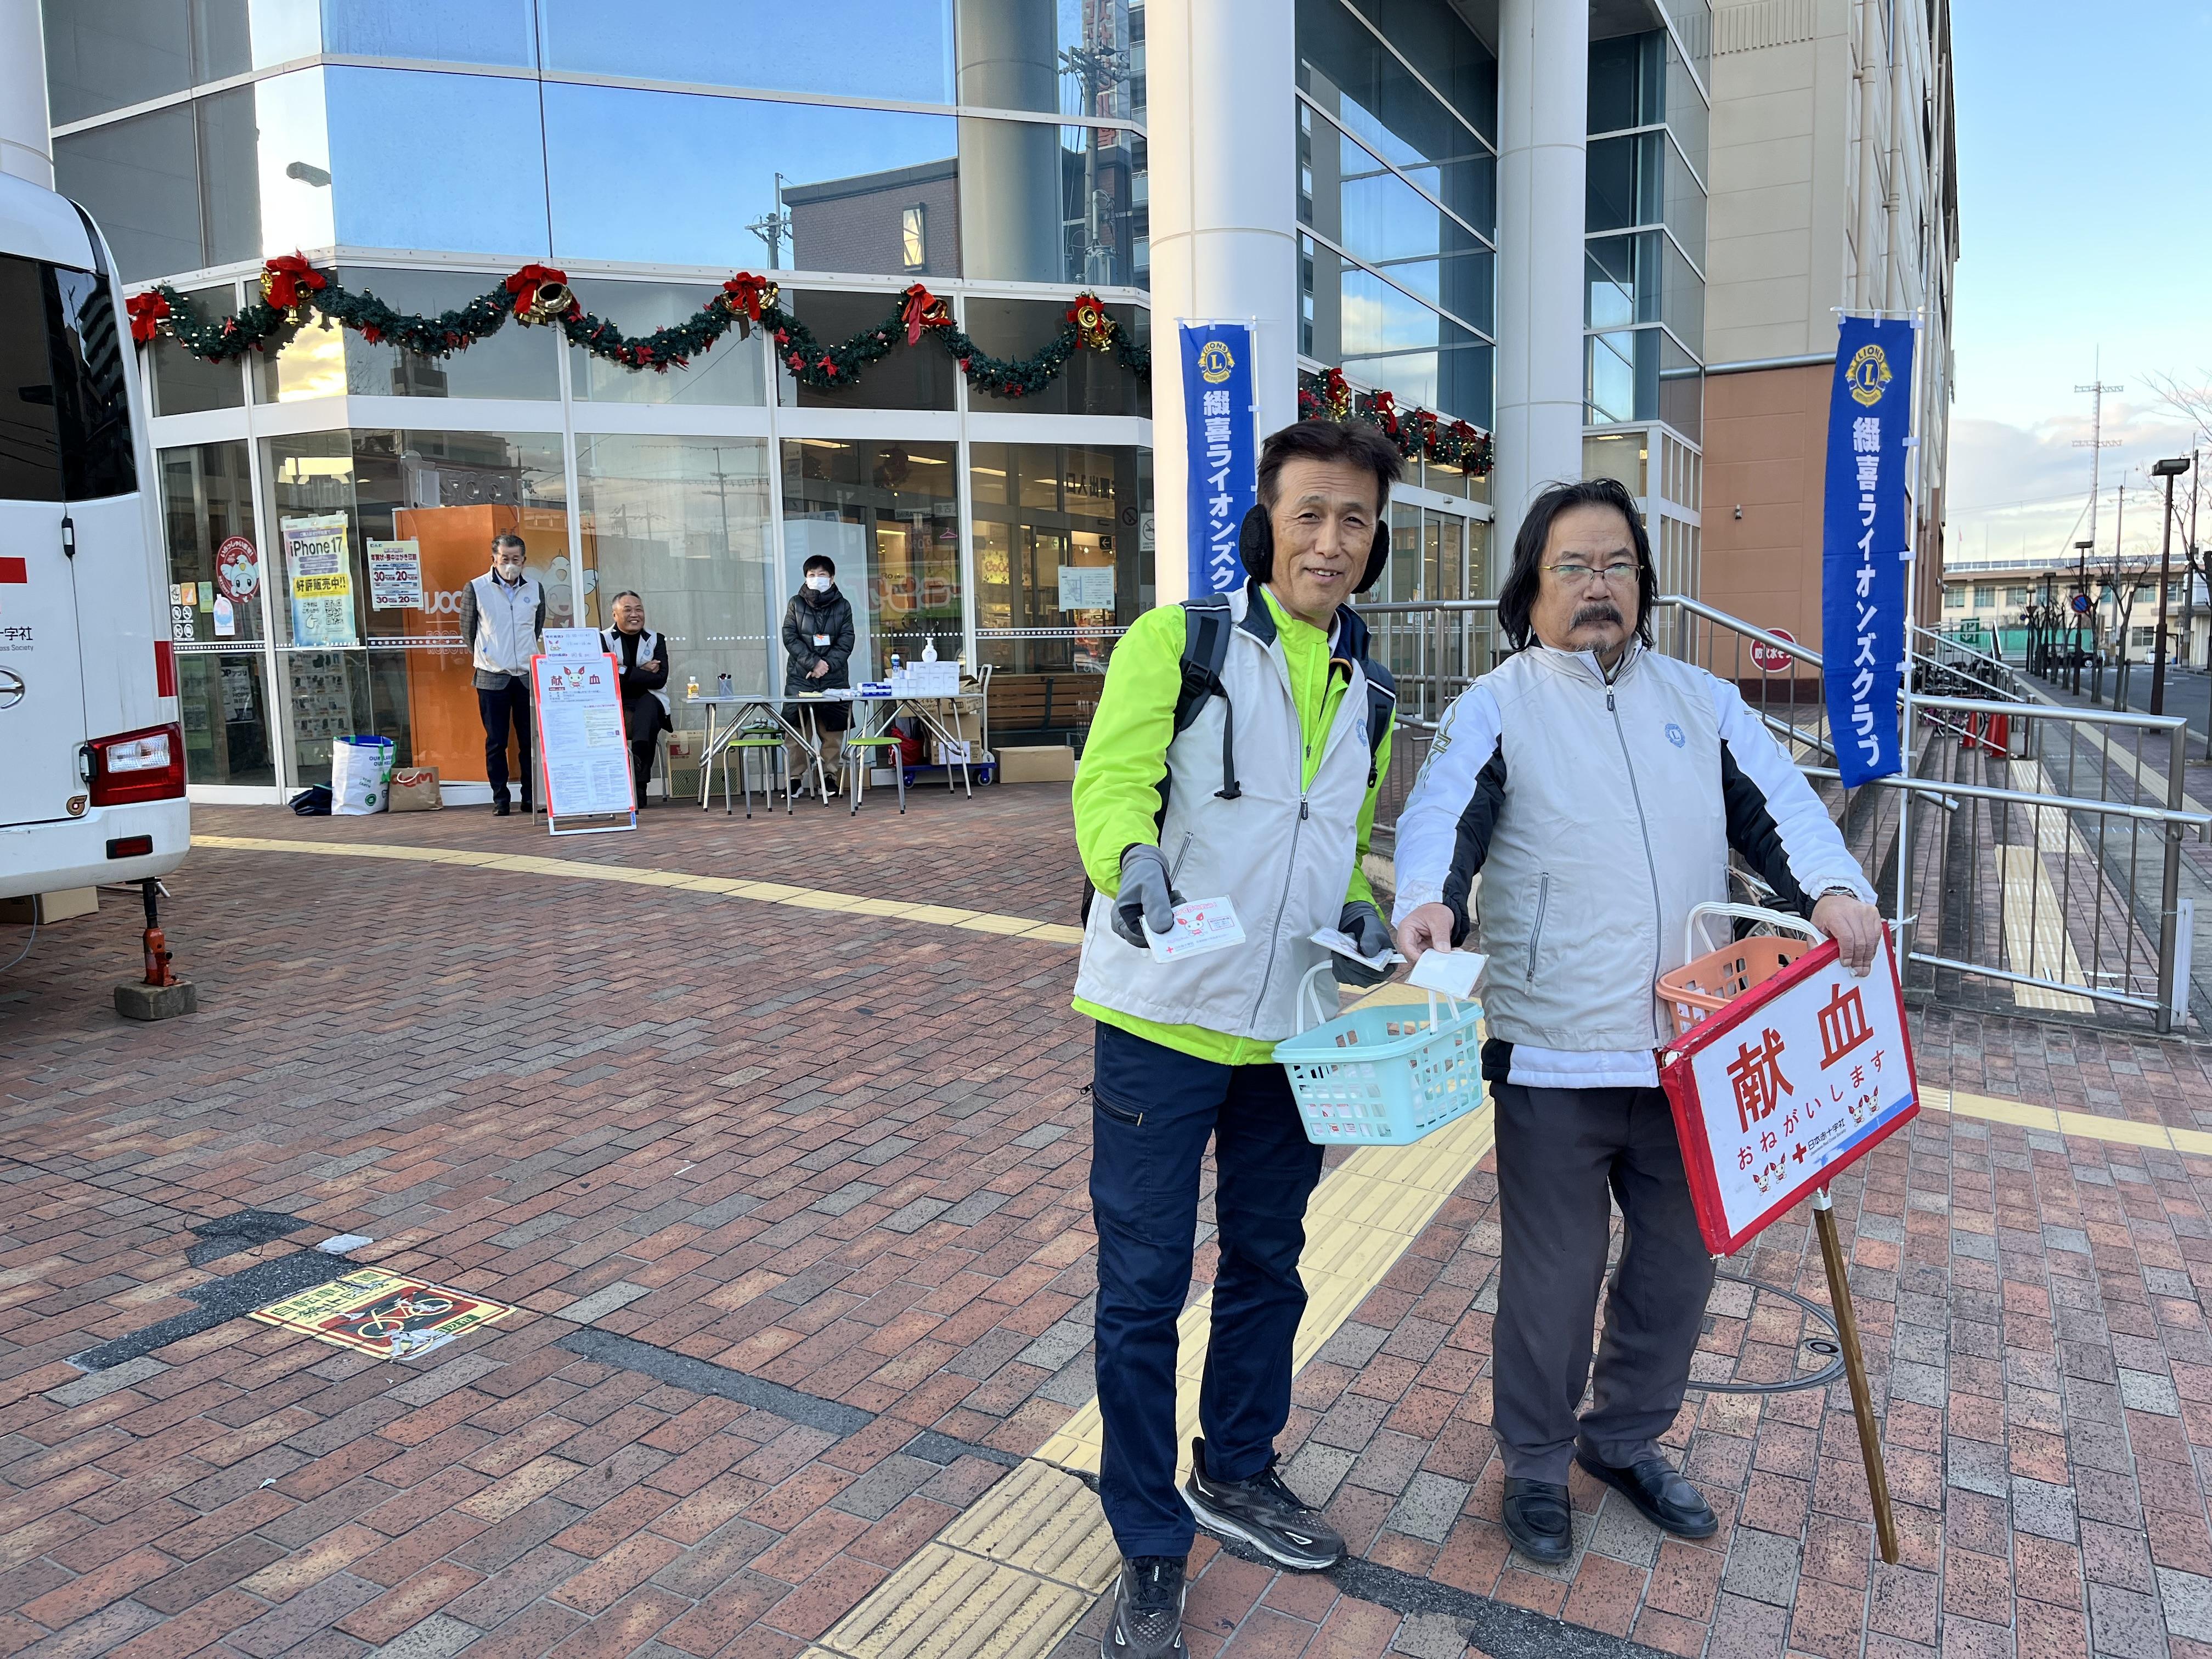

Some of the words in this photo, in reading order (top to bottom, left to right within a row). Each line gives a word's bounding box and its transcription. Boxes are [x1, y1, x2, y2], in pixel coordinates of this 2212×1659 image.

[1204, 342, 1227, 353] LIONS
[1858, 346, 1883, 360] LIONS
[1210, 354, 1222, 370] L
[1864, 364, 1876, 386] L
[1203, 390, 1236, 595] 綴喜ライオンズク
[290, 540, 330, 557] iPhone
[331, 536, 343, 553] 17
[1852, 416, 1882, 768] 綴喜ライオンズクラブ
[0, 627, 33, 641] 字社
[550, 675, 563, 686] 献
[589, 674, 601, 685] 血
[1737, 1049, 1886, 1171] おねがいします
[1808, 1118, 1845, 1150] 日本赤十字社
